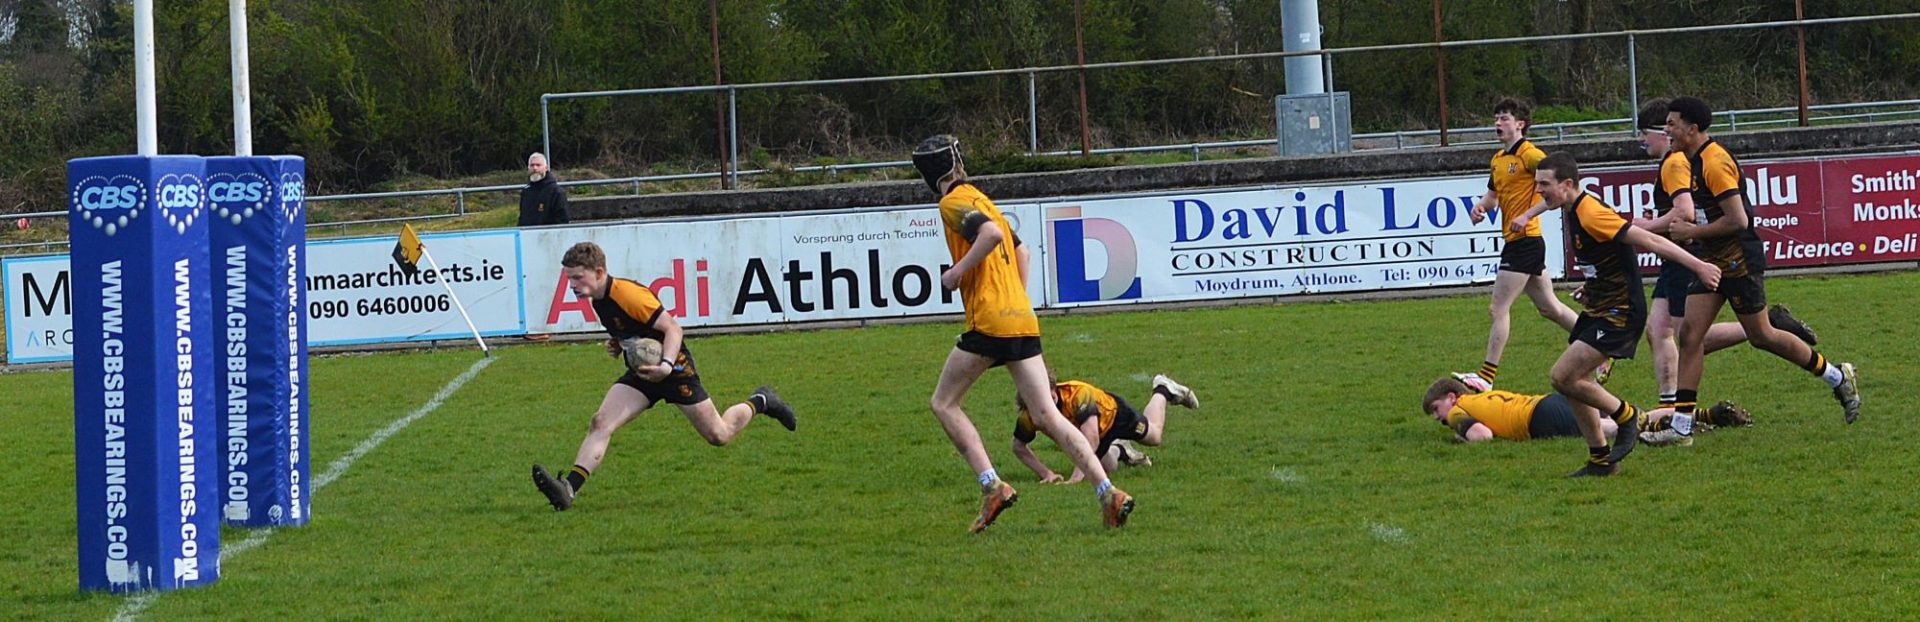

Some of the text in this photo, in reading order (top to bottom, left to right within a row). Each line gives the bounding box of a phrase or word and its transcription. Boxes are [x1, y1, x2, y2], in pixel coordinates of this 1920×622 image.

[208, 181, 264, 202] CBS
[282, 180, 301, 202] CBS
[1851, 169, 1920, 193] Smith'
[82, 185, 138, 210] CBS
[161, 184, 200, 208] CBS
[909, 217, 937, 228] Audi
[1168, 187, 1503, 244] David Low
[1753, 213, 1799, 230] People
[793, 229, 939, 245] Vorsprung durch Technik
[1774, 240, 1855, 260] Licence
[1873, 233, 1918, 254] Deli
[1171, 236, 1504, 271] CONSTRUCTION LT
[546, 258, 710, 325] Adi
[1195, 263, 1498, 295] Moydrum, Athlone. Tel: 090 64 74
[309, 294, 450, 320] 090 6460006
[174, 258, 199, 581] WWW.CBSBEARINGS.COM
